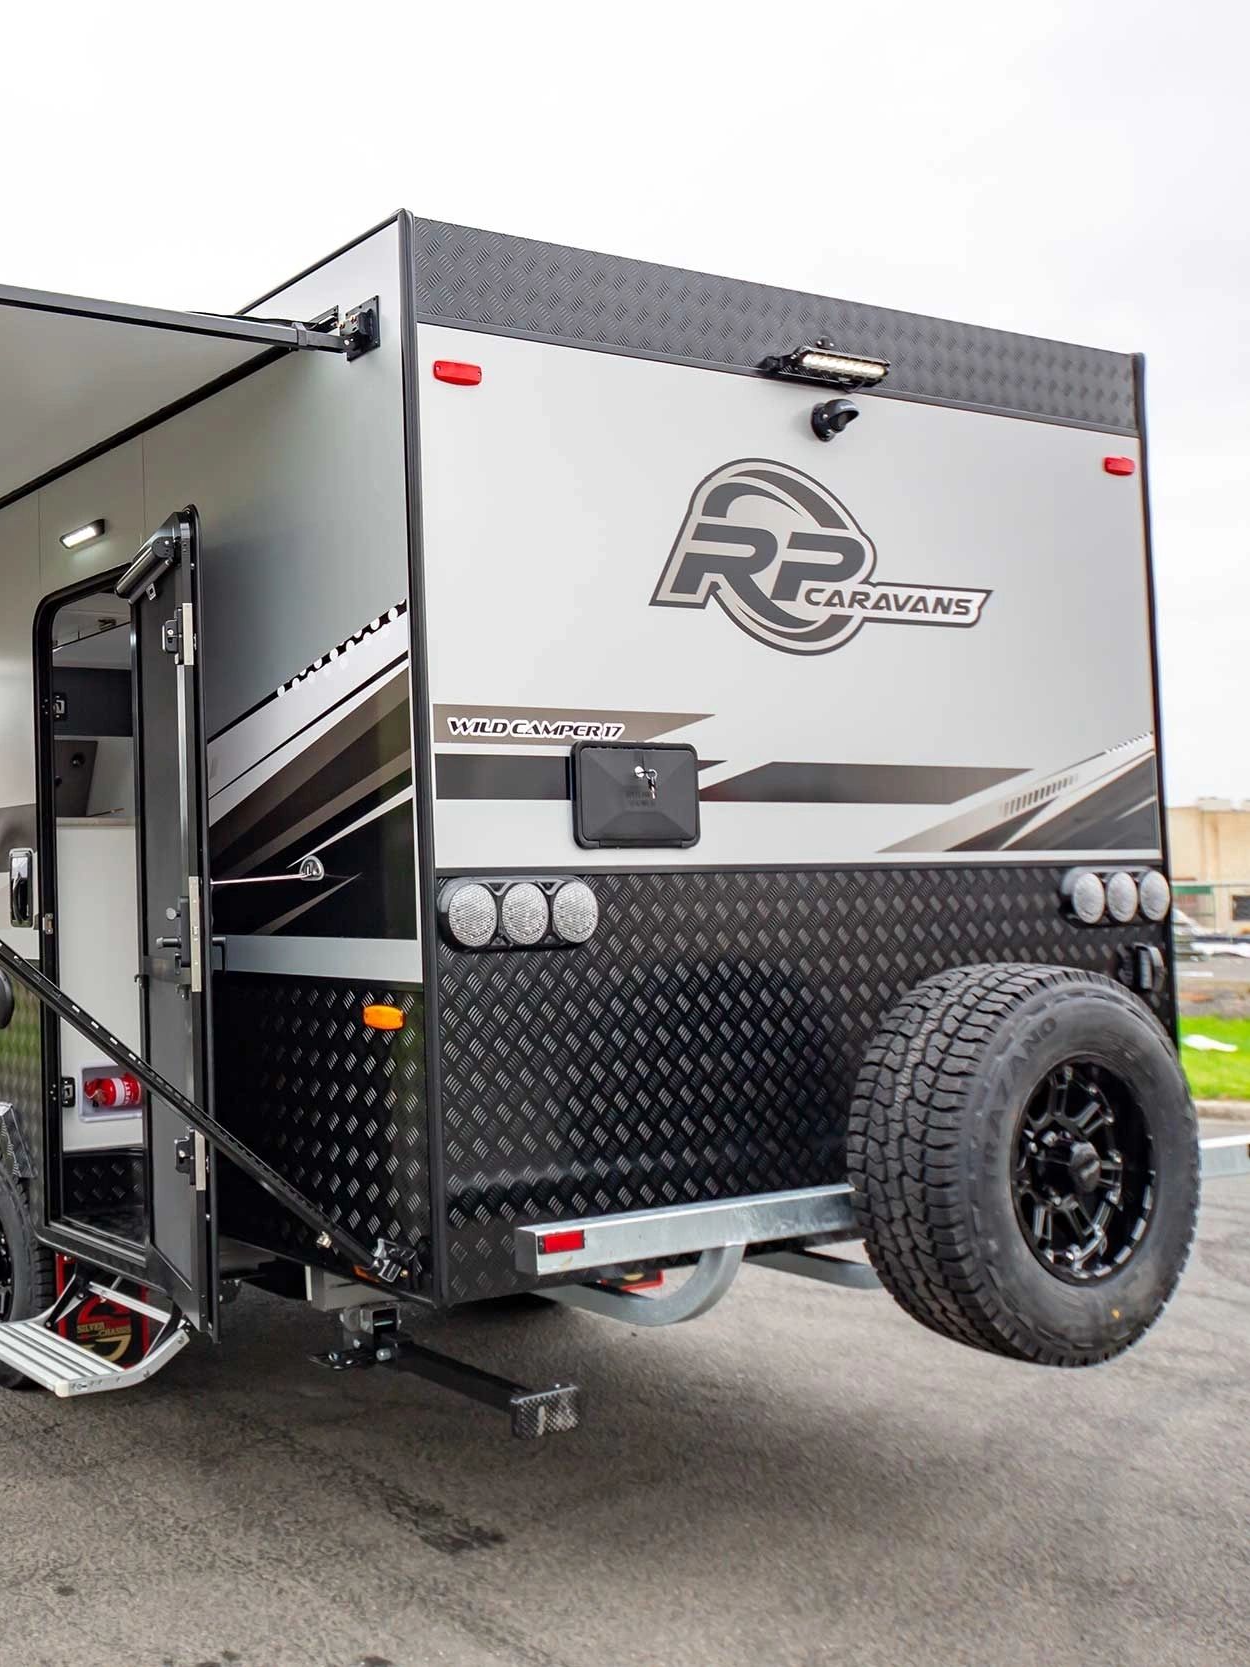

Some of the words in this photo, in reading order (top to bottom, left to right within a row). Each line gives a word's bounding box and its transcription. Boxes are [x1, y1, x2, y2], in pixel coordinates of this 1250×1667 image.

[804, 586, 975, 616] CARAVANS
[449, 719, 508, 735] WILD
[511, 722, 600, 738] CAMPER
[603, 725, 623, 738] 17
